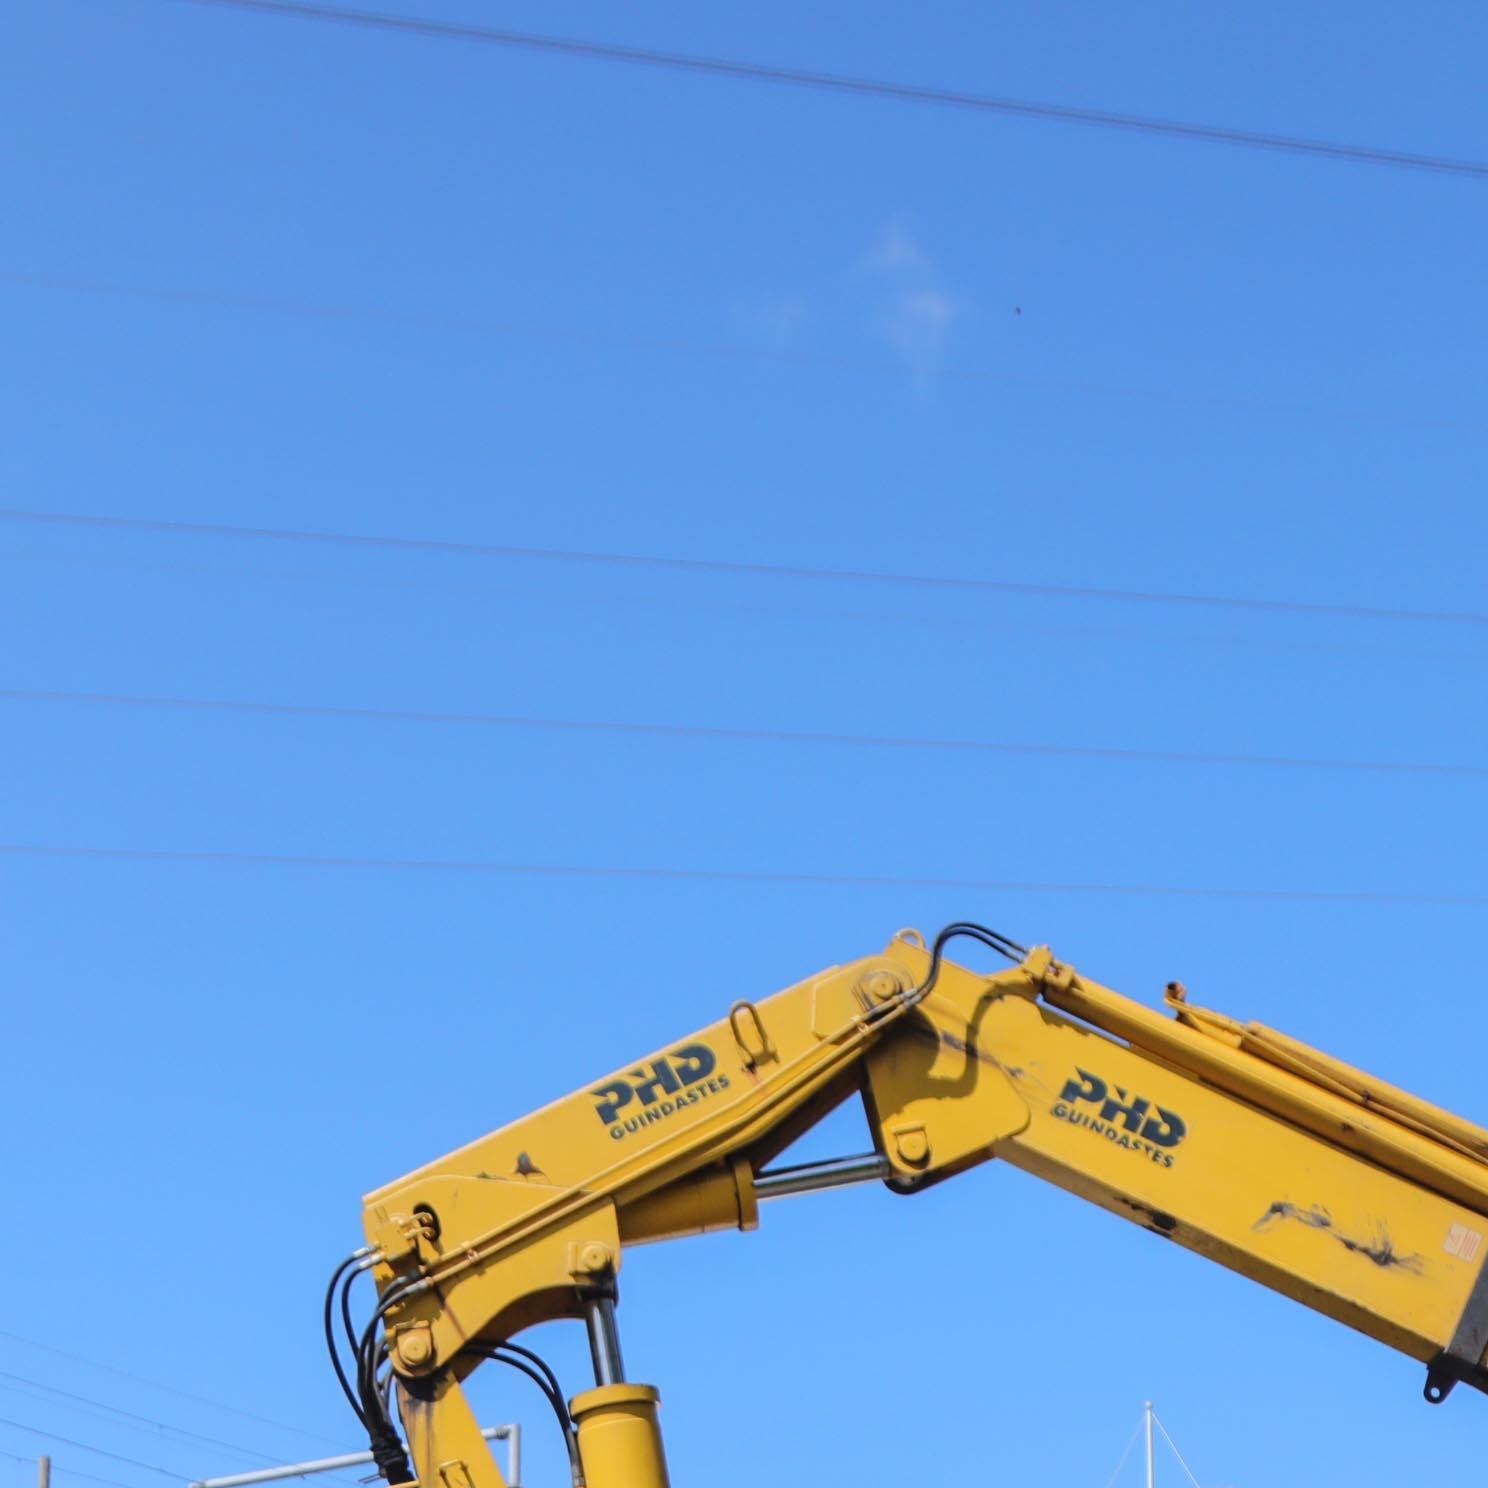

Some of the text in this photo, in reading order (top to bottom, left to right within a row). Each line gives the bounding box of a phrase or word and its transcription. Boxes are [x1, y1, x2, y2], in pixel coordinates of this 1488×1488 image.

[590, 1043, 717, 1126] PHD
[609, 1073, 730, 1140] GUINDASTES
[1059, 1065, 1187, 1148] PHD
[1051, 1102, 1174, 1169] GUINDASTES
